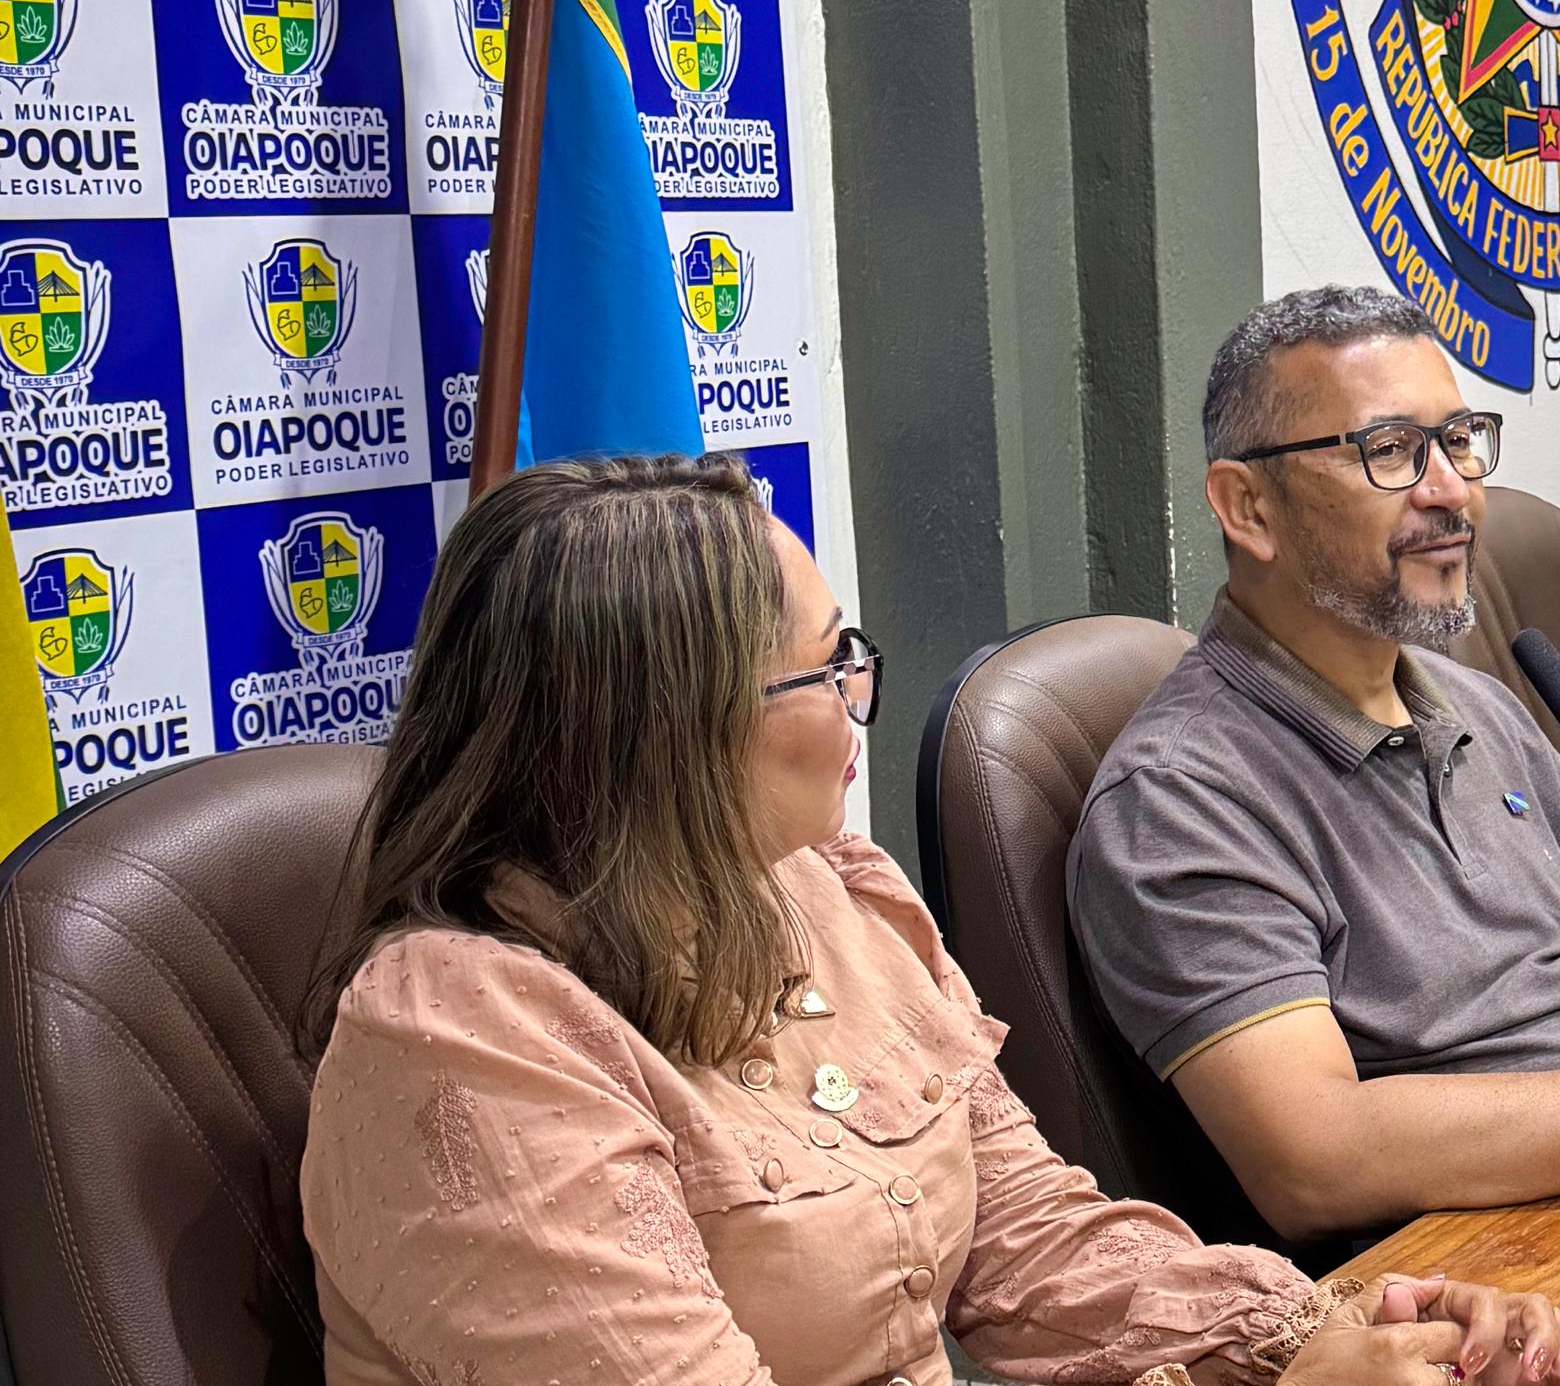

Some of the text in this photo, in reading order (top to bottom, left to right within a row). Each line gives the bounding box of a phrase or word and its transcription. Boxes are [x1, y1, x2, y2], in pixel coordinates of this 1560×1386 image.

[0, 65, 44, 77] ESDE 1970
[262, 75, 305, 86] DESDE 1970
[15, 102, 134, 123] MUNICIPAL
[186, 103, 380, 128] CÂMARA MUNICIPAL
[424, 110, 495, 130] CÂMARA
[640, 116, 770, 137] ÂMARA MUNICIPAL
[0, 126, 138, 175] POQUE
[188, 129, 383, 175] OIAPOQUE
[426, 134, 500, 171] OIAP
[650, 140, 772, 177] IAPOQUE
[0, 178, 143, 195] LEGISLATIVO
[191, 178, 388, 194] PODER LEGISLATIVO
[428, 178, 485, 193] PODER
[686, 180, 777, 193] LEGISLATIVO
[1305, 5, 1491, 369] 15 de Novembro
[286, 358, 328, 370] DESDE 1970
[715, 358, 786, 375] MUNICIPAL
[22, 375, 72, 388] DESDE 1970
[211, 387, 401, 413] CÂMARA MUNICIPAL
[699, 376, 788, 414] POQUE
[45, 405, 161, 428] MUNICIPAL
[704, 414, 793, 433] LEGISLATIVO
[213, 408, 405, 460] OIAPOQUE
[0, 429, 165, 481] APOQUE
[216, 452, 409, 483] PODER LEGISLATIVO
[26, 476, 169, 504] LEGISLATIVO
[309, 631, 350, 647] DESDE 1970
[51, 674, 100, 691] DESDE 1970
[235, 655, 410, 697] CÂMARA MUNICIPA
[72, 695, 185, 728] MUNICIPAL
[237, 675, 407, 741] OIAPOQU
[54, 717, 189, 779] POQUE
